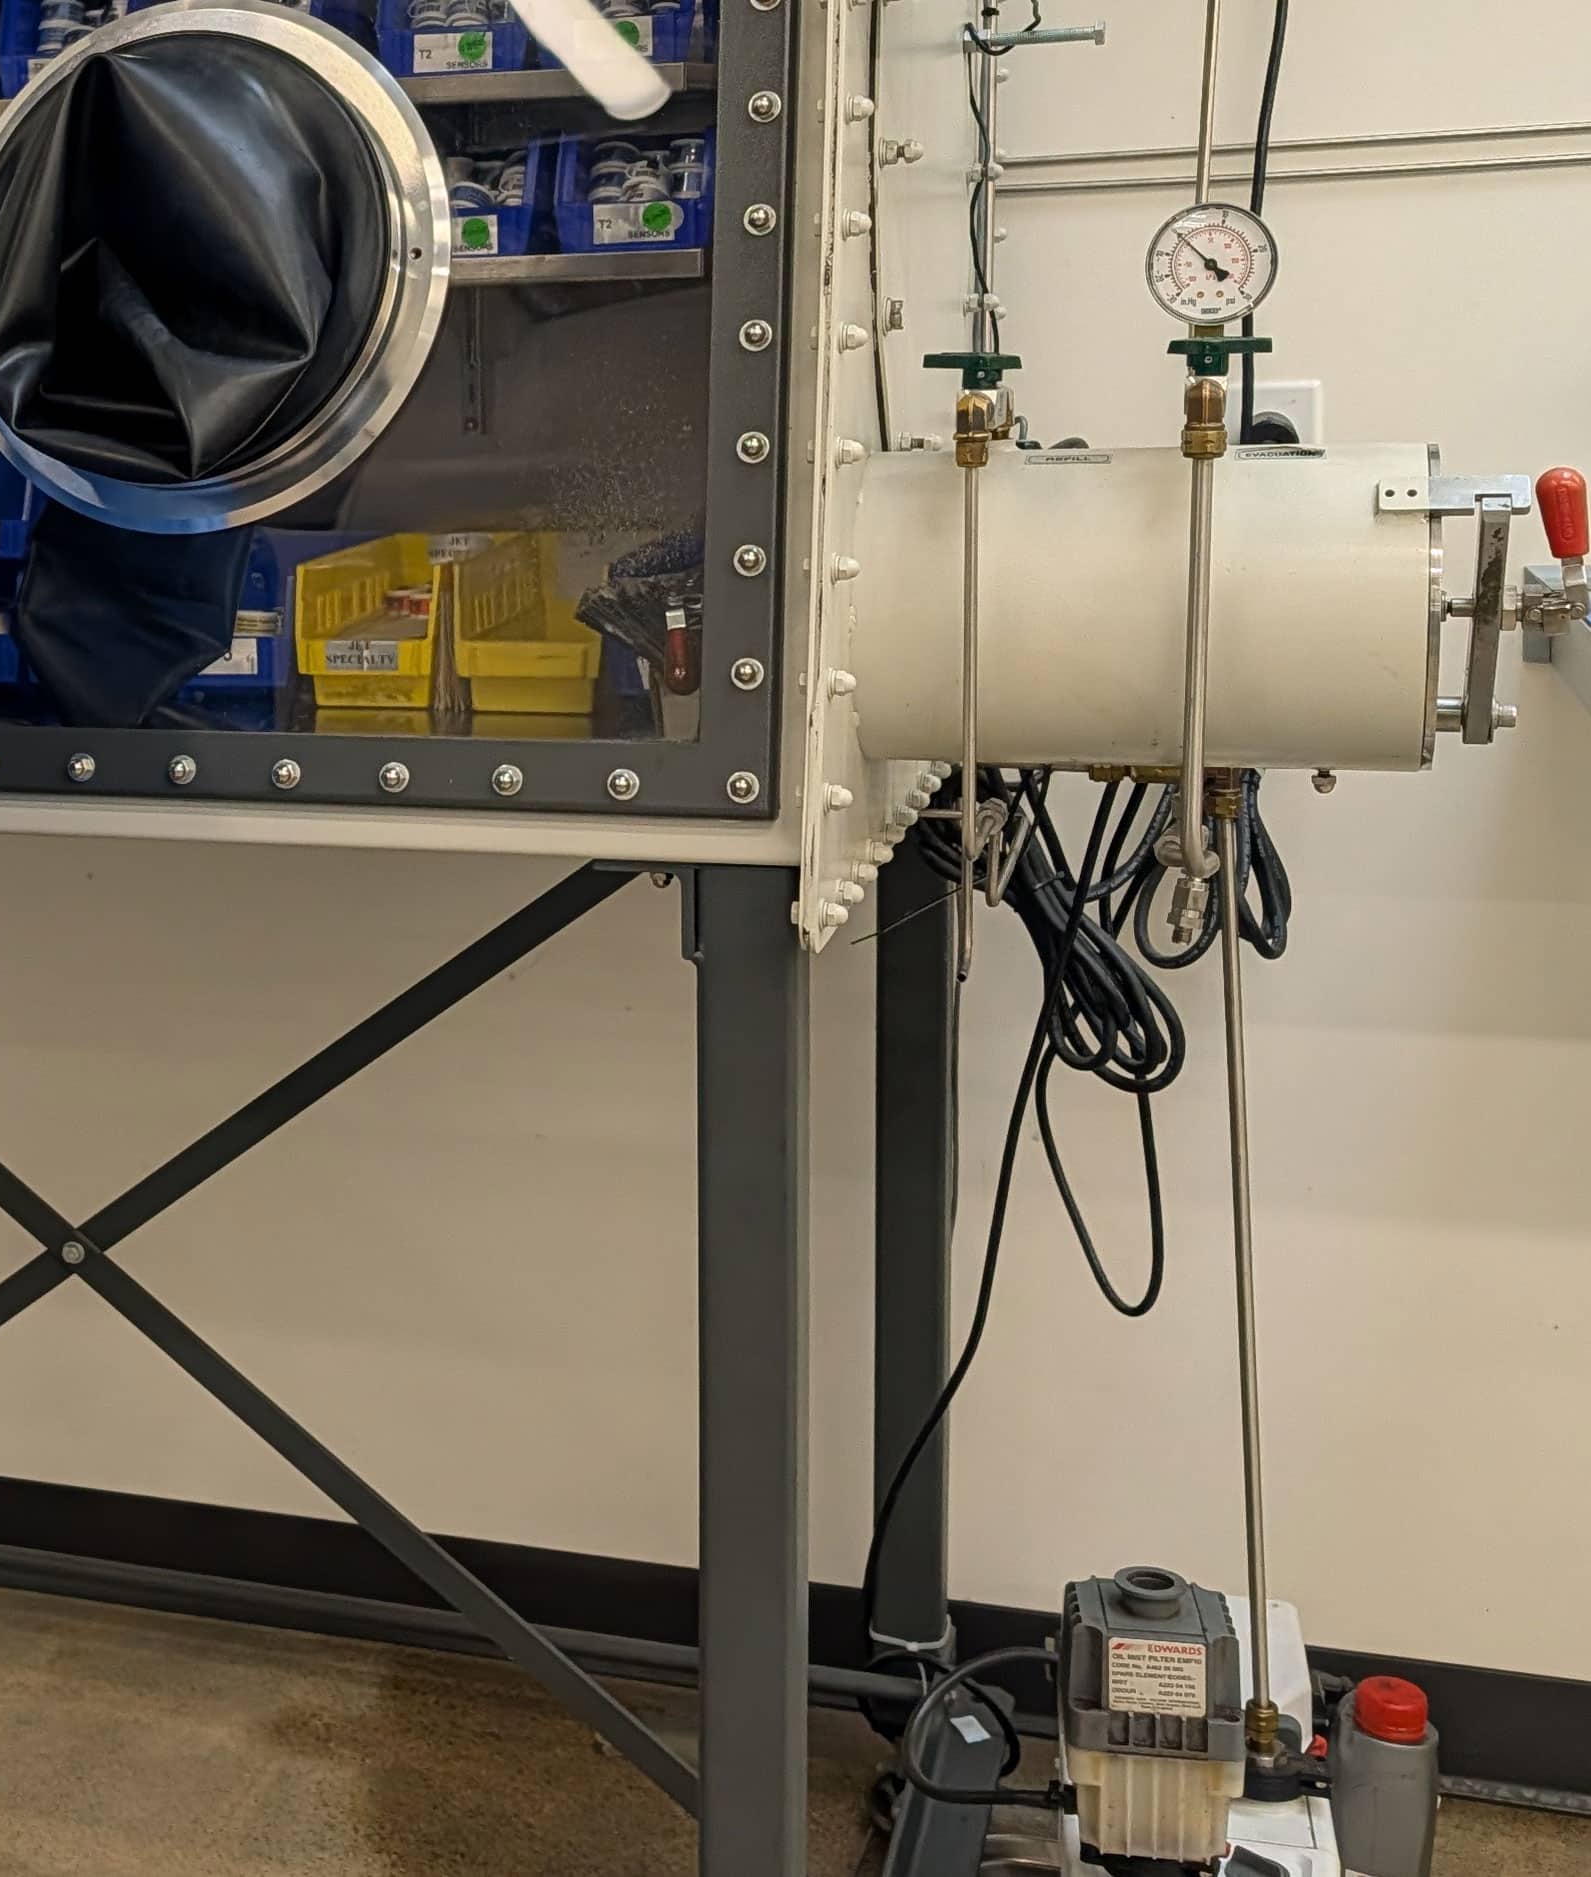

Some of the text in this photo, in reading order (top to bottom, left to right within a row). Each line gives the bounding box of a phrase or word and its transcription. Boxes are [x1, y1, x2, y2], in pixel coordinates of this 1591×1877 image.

[419, 49, 432, 59] T2
[598, 219, 613, 230] T2
[627, 229, 670, 239] SENSORS
[1244, 450, 1316, 459] EVACUATION
[326, 654, 394, 665] SPECIALTY
[1147, 1644, 1203, 1656] EDWARDS
[1148, 1655, 1176, 1663] FILTER
[1135, 1672, 1166, 1680] ELEMENT
